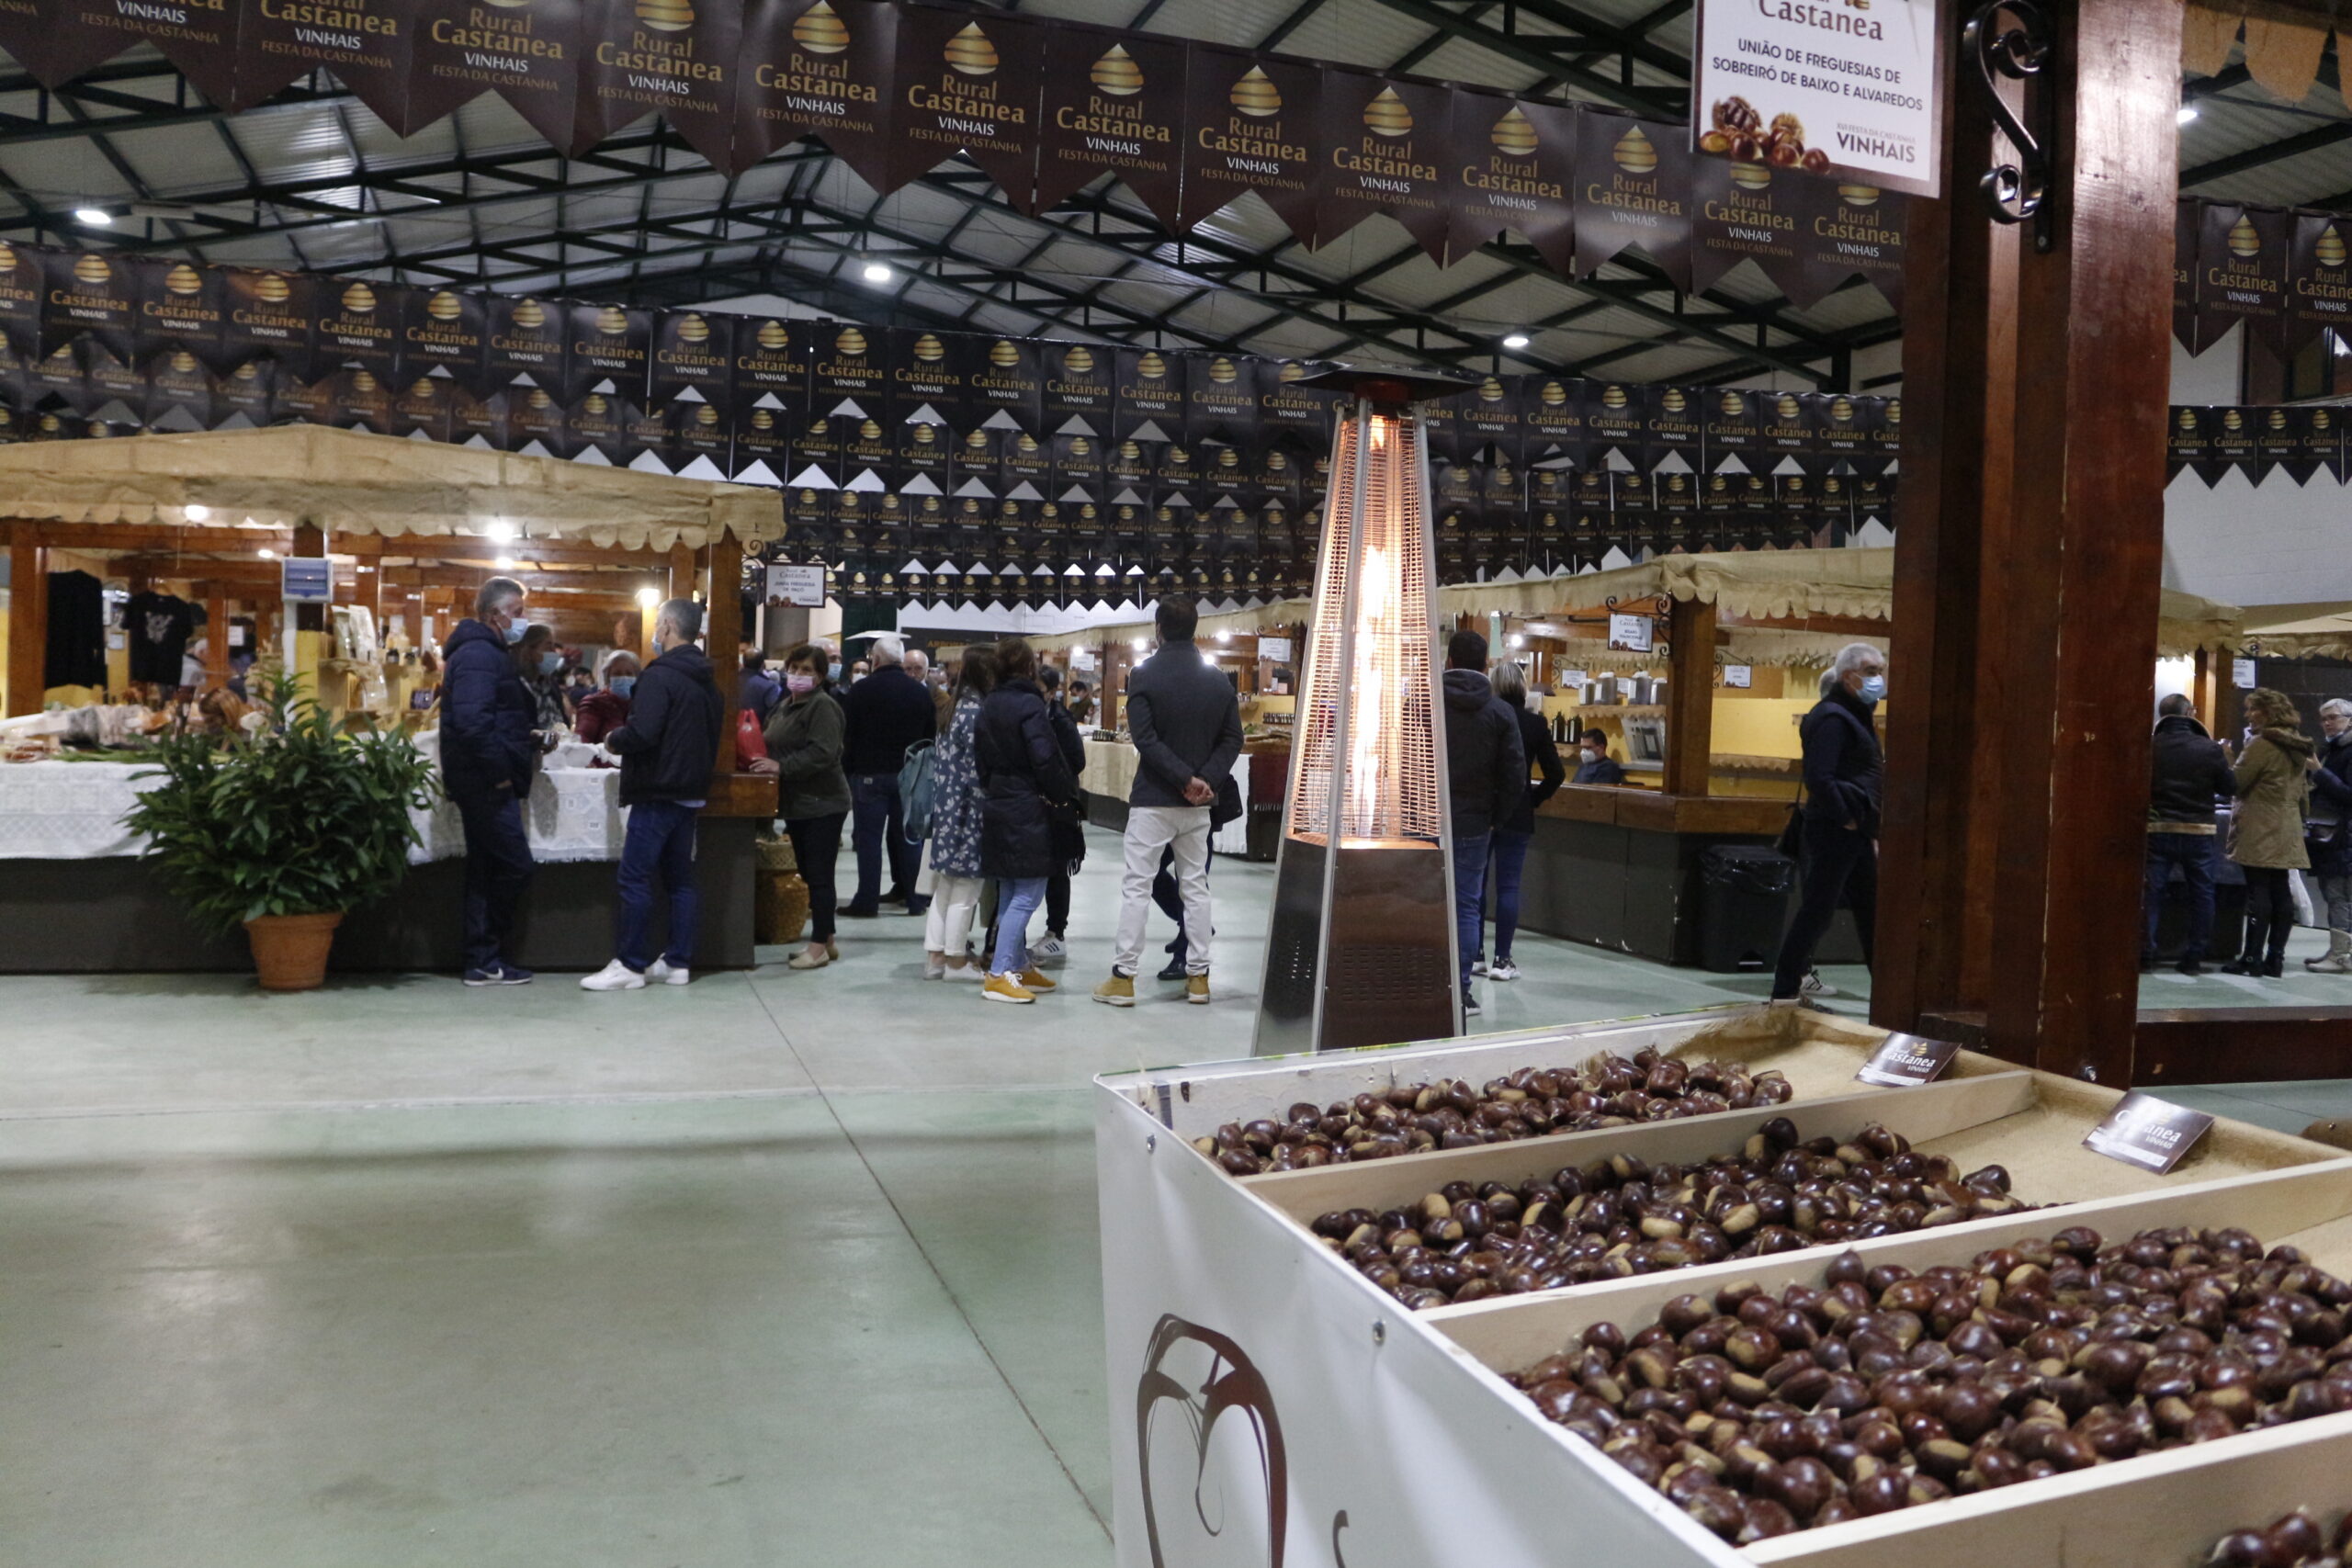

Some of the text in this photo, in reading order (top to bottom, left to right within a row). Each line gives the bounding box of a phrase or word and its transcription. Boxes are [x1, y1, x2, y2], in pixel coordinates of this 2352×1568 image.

[117, 0, 187, 24] VINHAIS
[260, 0, 398, 36] Castanea
[469, 7, 532, 34] Rural
[1759, 0, 1883, 40] Castanea
[294, 28, 361, 50] VINHAIS
[432, 18, 563, 60] Castanea
[633, 31, 693, 58] Rural
[262, 40, 392, 69] FESTA DA CASTANHA
[465, 51, 529, 73] VINHAIS
[596, 42, 723, 82] Castanea
[1738, 39, 1901, 84] UNIÃO DE FREGUESIAS DE
[791, 53, 848, 79] Rural
[433, 64, 559, 91] FESTA DA CASTANHA
[628, 74, 690, 95] VINHAIS
[755, 64, 877, 103] Castanea
[943, 74, 997, 100] Rural
[1713, 57, 1923, 111] SOBREIRÓ DE BAIXO E ALVAREDOS
[598, 86, 718, 113] FESTA DA CASTANHA
[786, 96, 845, 116] VINHAIS
[909, 85, 1025, 123] Castanea
[1089, 96, 1143, 120] Rural
[756, 107, 874, 133] FESTA DA CASTANHA
[938, 116, 994, 136] VINHAIS
[1057, 107, 1170, 142] Castanea
[1229, 117, 1281, 141] Rural
[910, 128, 1022, 154] FESTA DA CASTANHA
[1086, 137, 1141, 155] VINHAIS
[1198, 127, 1307, 162] Castanea
[1363, 137, 1412, 160] Rural
[1837, 131, 1916, 163] VINHAIS
[1058, 148, 1167, 172] FESTA DA CASTANHA
[1227, 156, 1279, 175] VINHAIS
[1333, 147, 1437, 181] Castanea
[1490, 155, 1538, 178] Rural
[1201, 168, 1305, 191] FESTA DA CASTANHA
[1360, 175, 1410, 194] VINHAIS
[1463, 165, 1562, 198] Castanea
[1613, 174, 1657, 196] Rural
[1336, 186, 1435, 209] FESTA DA CASTANHA
[1488, 194, 1537, 211] VINHAIS
[1588, 183, 1680, 216] Castanea
[1730, 190, 1772, 211] Rural
[1612, 210, 1657, 228] VINHAIS
[1704, 200, 1793, 231] Castanea
[1838, 207, 1880, 227] Rural
[1728, 227, 1772, 243] VINHAIS
[1815, 216, 1902, 246] Castanea
[1838, 243, 1880, 258] VINHAIS
[2228, 258, 2260, 275] Rural
[2315, 267, 2346, 284] Rural
[2209, 267, 2278, 292] Castanea
[2297, 277, 2352, 299] Castane
[51, 290, 128, 310] Castanea
[2227, 290, 2260, 303] VINHAIS
[2314, 300, 2346, 312] VINHAIS
[70, 309, 108, 320] VINHAIS
[143, 301, 220, 321] Castanea
[232, 309, 307, 329] Castanea
[162, 319, 200, 331] VINHAIS
[251, 327, 288, 338] VINHAIS
[320, 318, 392, 338] Castanea
[337, 336, 373, 347] VINHAIS
[407, 327, 478, 345] Castanea
[491, 334, 561, 354] Castanea
[424, 344, 460, 355] VINHAIS
[508, 352, 544, 362] VINHAIS
[575, 341, 644, 359] Castanea
[658, 349, 726, 367] Castanea
[592, 358, 626, 368] VINHAIS
[674, 366, 708, 375] VINHAIS
[738, 355, 805, 374] Castanea
[818, 362, 883, 379] Castanea
[754, 372, 787, 382] VINHAIS
[834, 378, 865, 388] VINHAIS
[895, 368, 960, 385] Castanea
[971, 374, 1035, 390] Castanea
[911, 384, 944, 393] VINHAIS
[988, 389, 1019, 399] VINHAIS
[1047, 379, 1109, 396] Castanea
[1120, 386, 1182, 401] Castanea
[1063, 395, 1093, 404] VINHAIS
[1136, 400, 1166, 410] VINHAIS
[1193, 390, 1252, 406] Castanea
[1263, 395, 1321, 411] Castanea
[1207, 405, 1238, 414] VINHAIS
[1278, 410, 1306, 419] VINHAIS
[1464, 409, 1518, 423] Castanea
[1528, 412, 1580, 426] Castanea
[1542, 426, 1567, 434] VINHAIS
[1589, 415, 1640, 430] Castanea
[1649, 419, 1698, 433] Castanea
[1708, 423, 1757, 436] Castanea
[1765, 425, 1812, 439] Castanea
[1819, 428, 1865, 441] Castanea
[1888, 1051, 1936, 1067] astanea
